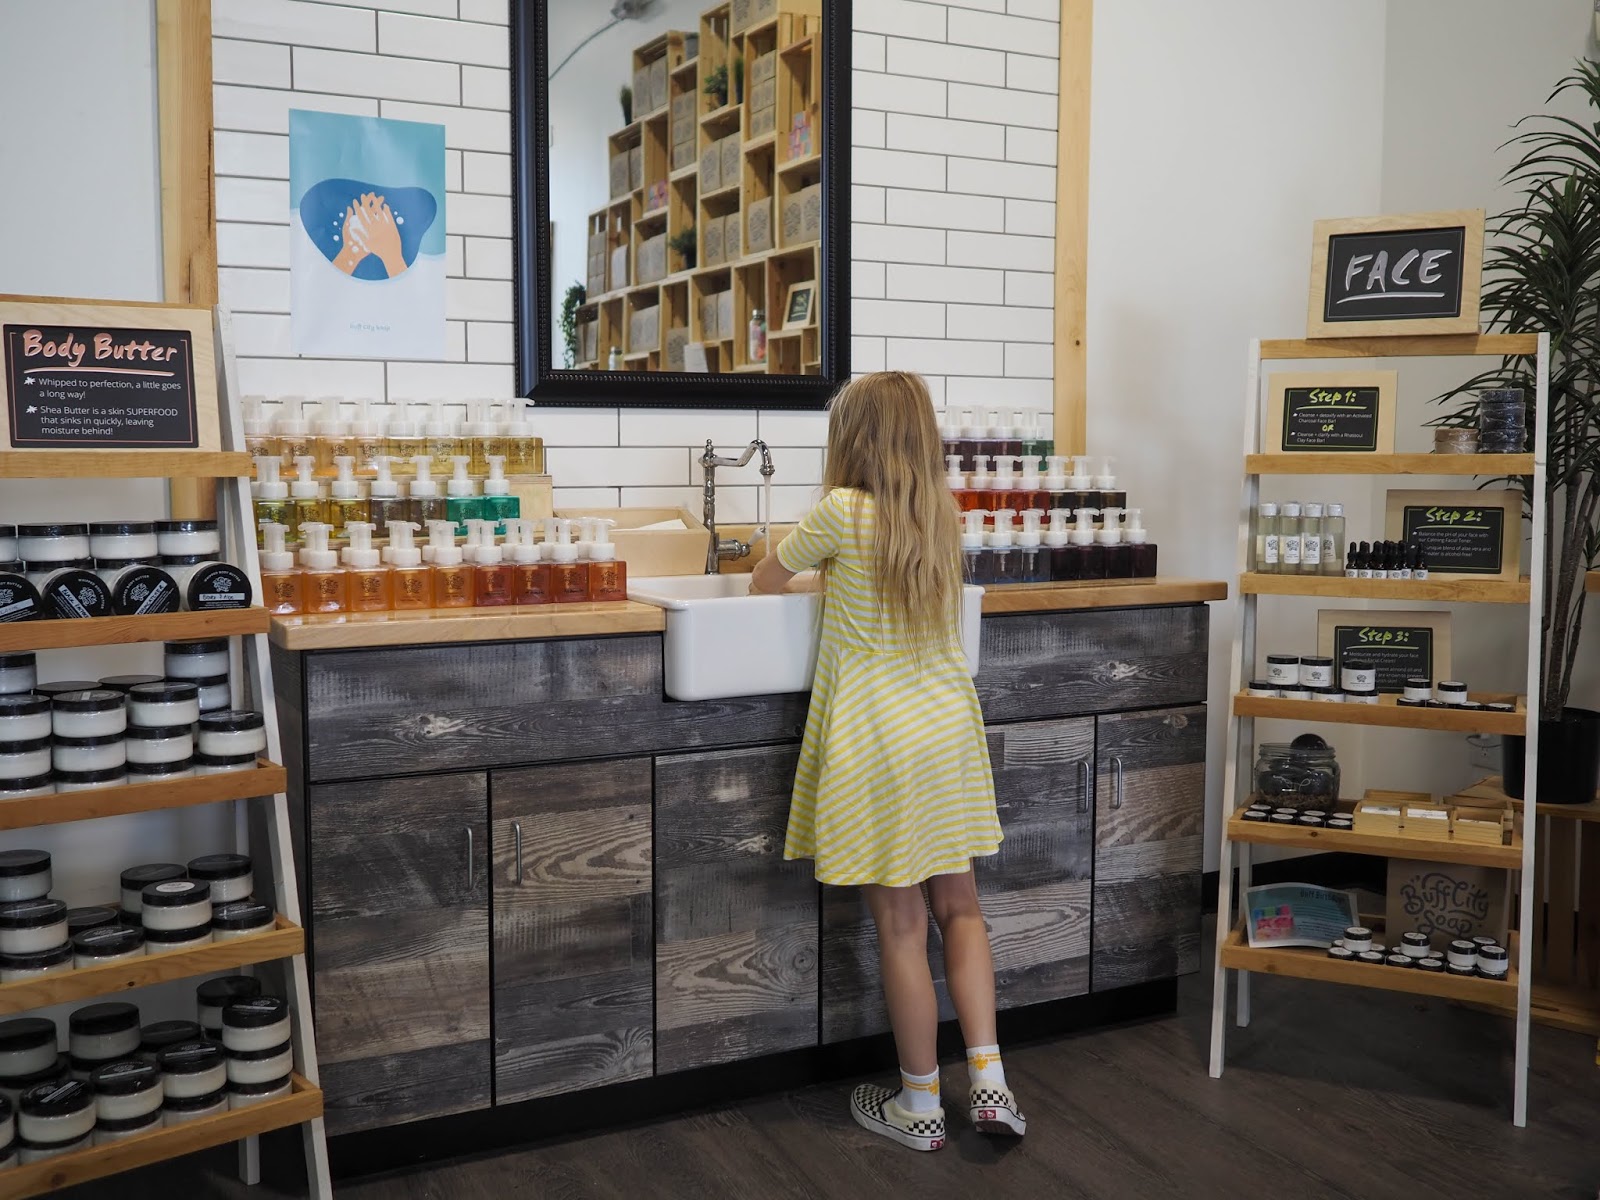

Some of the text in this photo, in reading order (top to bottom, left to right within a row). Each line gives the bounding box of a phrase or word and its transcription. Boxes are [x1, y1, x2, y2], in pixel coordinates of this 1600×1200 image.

[1346, 248, 1452, 292] FACE
[23, 329, 177, 367] Body Butter
[39, 378, 77, 387] Whipped
[79, 379, 87, 387] to
[90, 380, 133, 389] perfection,
[143, 381, 160, 389] little
[47, 390, 65, 399] long
[67, 391, 85, 399] way!
[1309, 388, 1357, 405] Step 1:
[41, 406, 61, 414] Shea
[92, 407, 99, 415] is
[127, 408, 177, 416] SUPERFOOD
[82, 427, 113, 435] behind!
[94, 418, 123, 427] quickly,
[126, 418, 153, 427] leaving
[1426, 507, 1482, 524] Step 2:
[1359, 627, 1409, 645] Step 3:
[1401, 880, 1489, 921] Buff City
[1418, 910, 1472, 938] Soap
